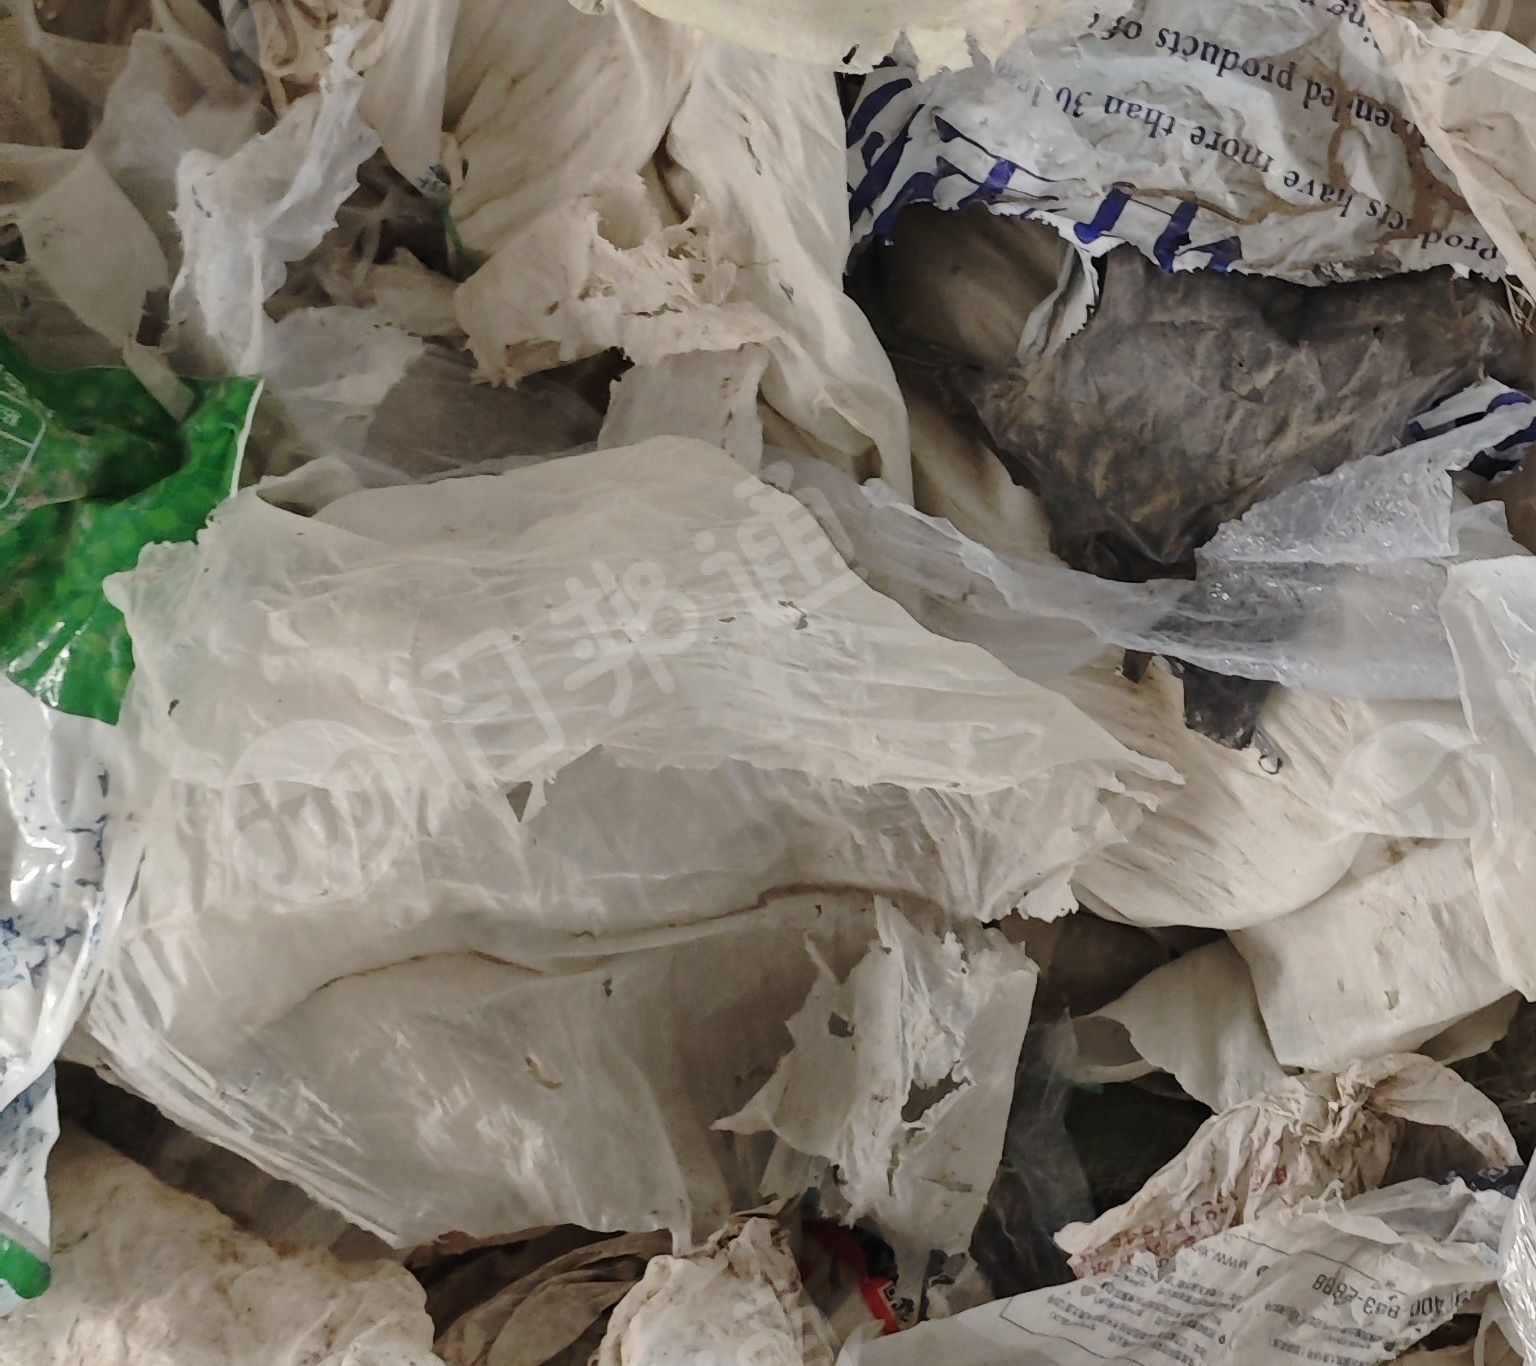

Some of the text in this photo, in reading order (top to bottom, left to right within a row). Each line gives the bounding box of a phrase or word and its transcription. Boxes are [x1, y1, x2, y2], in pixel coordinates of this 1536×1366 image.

[1154, 26, 1300, 91] products
[1104, 93, 1177, 139] than
[1189, 123, 1276, 174] more
[1283, 169, 1358, 219] have
[1367, 194, 1500, 263] Prodcts
